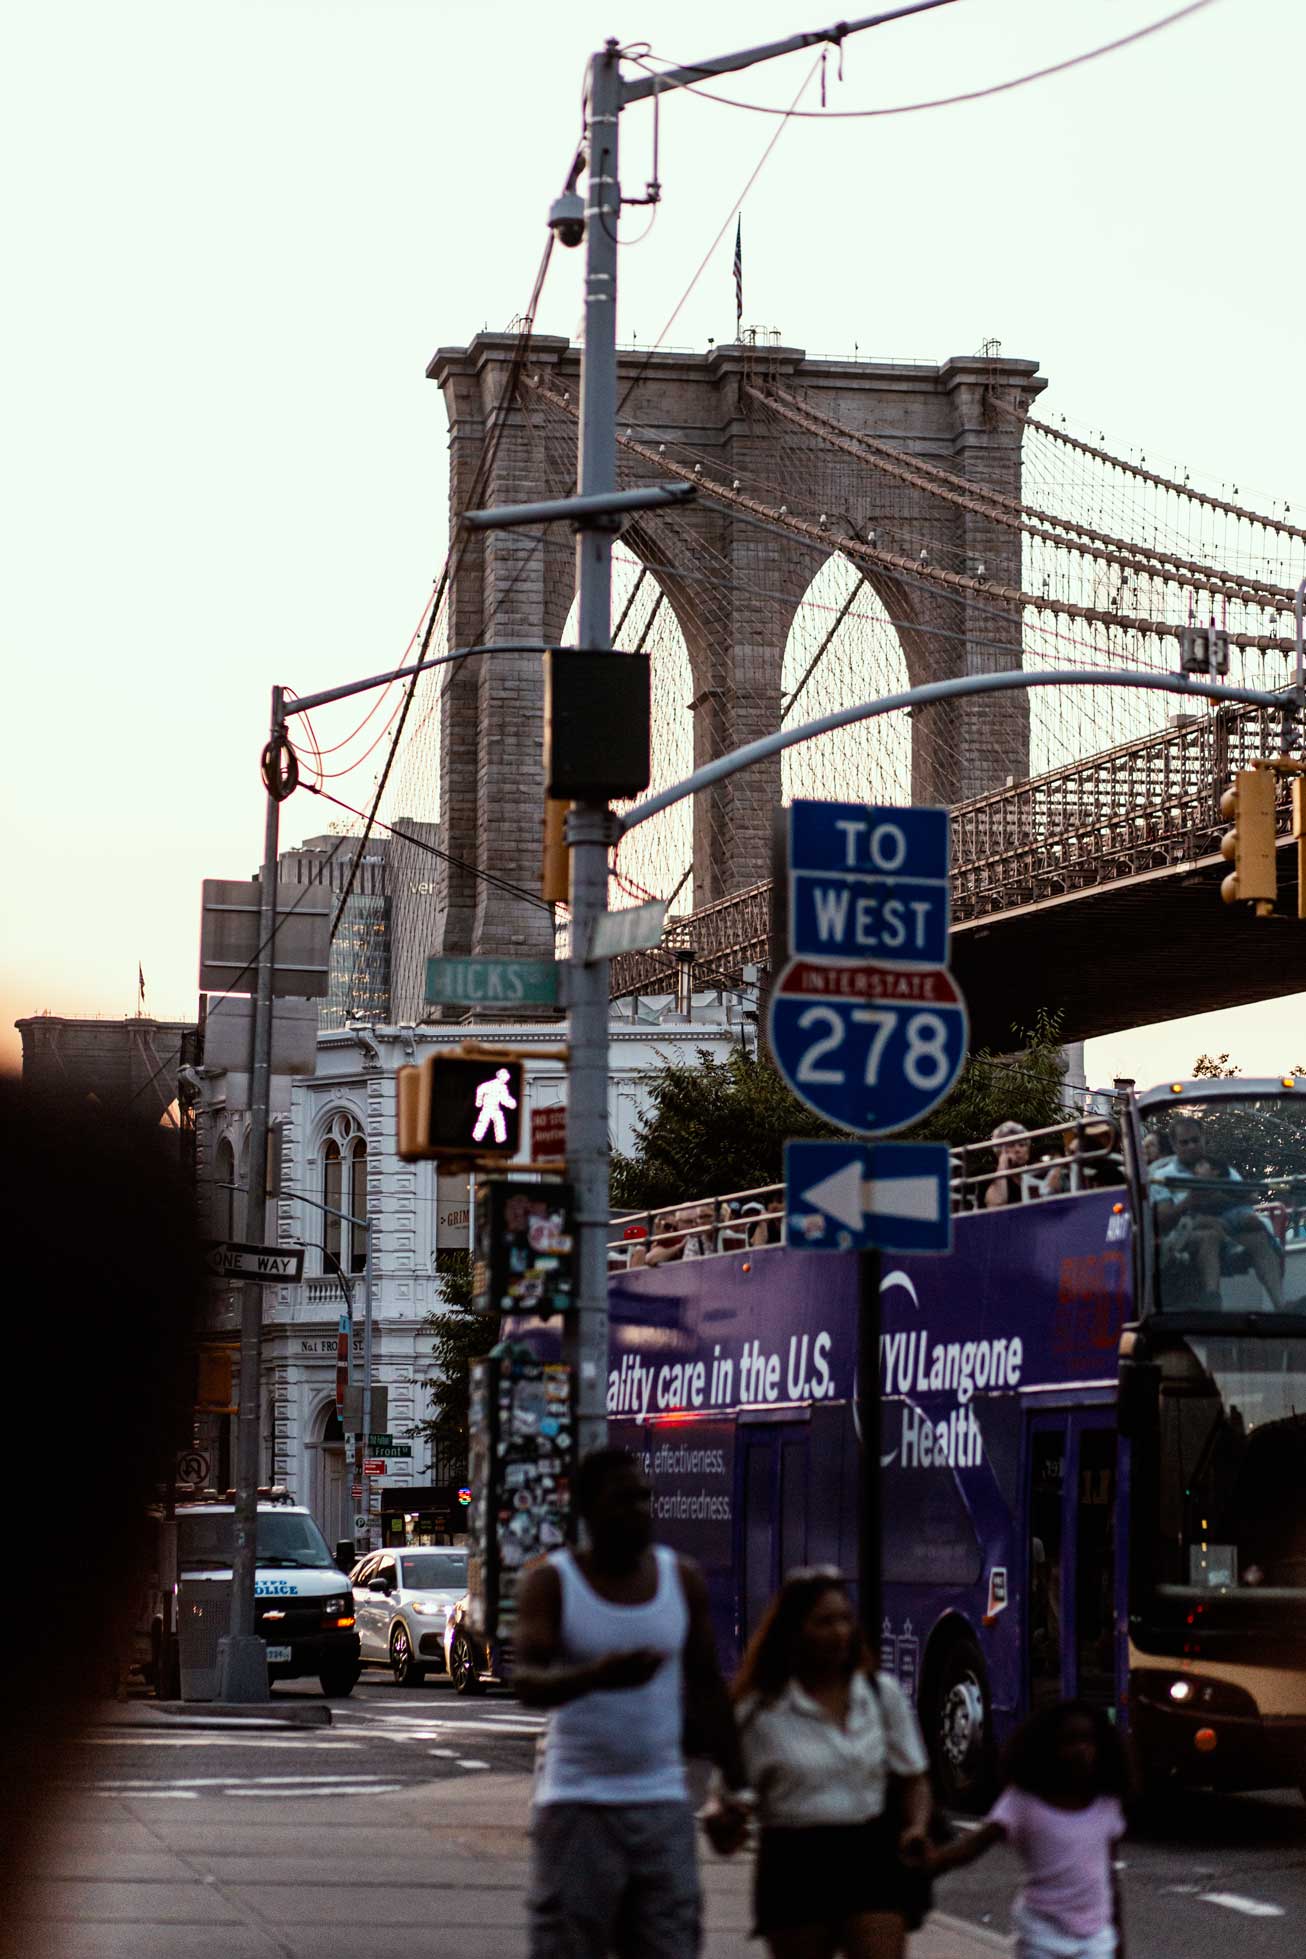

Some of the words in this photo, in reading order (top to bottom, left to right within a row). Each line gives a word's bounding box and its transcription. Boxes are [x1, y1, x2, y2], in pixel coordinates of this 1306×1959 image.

[835, 820, 907, 871] TO
[409, 881, 435, 895] ver
[813, 886, 932, 949] WEST
[436, 963, 524, 999] HICKS
[801, 964, 936, 1000] INTERSTATE
[797, 1006, 950, 1091] 278
[214, 1250, 243, 1269] ONE
[257, 1257, 290, 1273] WAY
[606, 1354, 654, 1425] ality
[656, 1360, 705, 1409] care
[709, 1344, 734, 1406] in
[739, 1340, 781, 1403] the
[787, 1330, 836, 1401] U.S.
[879, 1330, 917, 1394] YU
[916, 1330, 1023, 1404] Langone
[375, 1447, 401, 1457] Front
[901, 1402, 983, 1468] Health
[653, 1443, 726, 1476] effectiveness,
